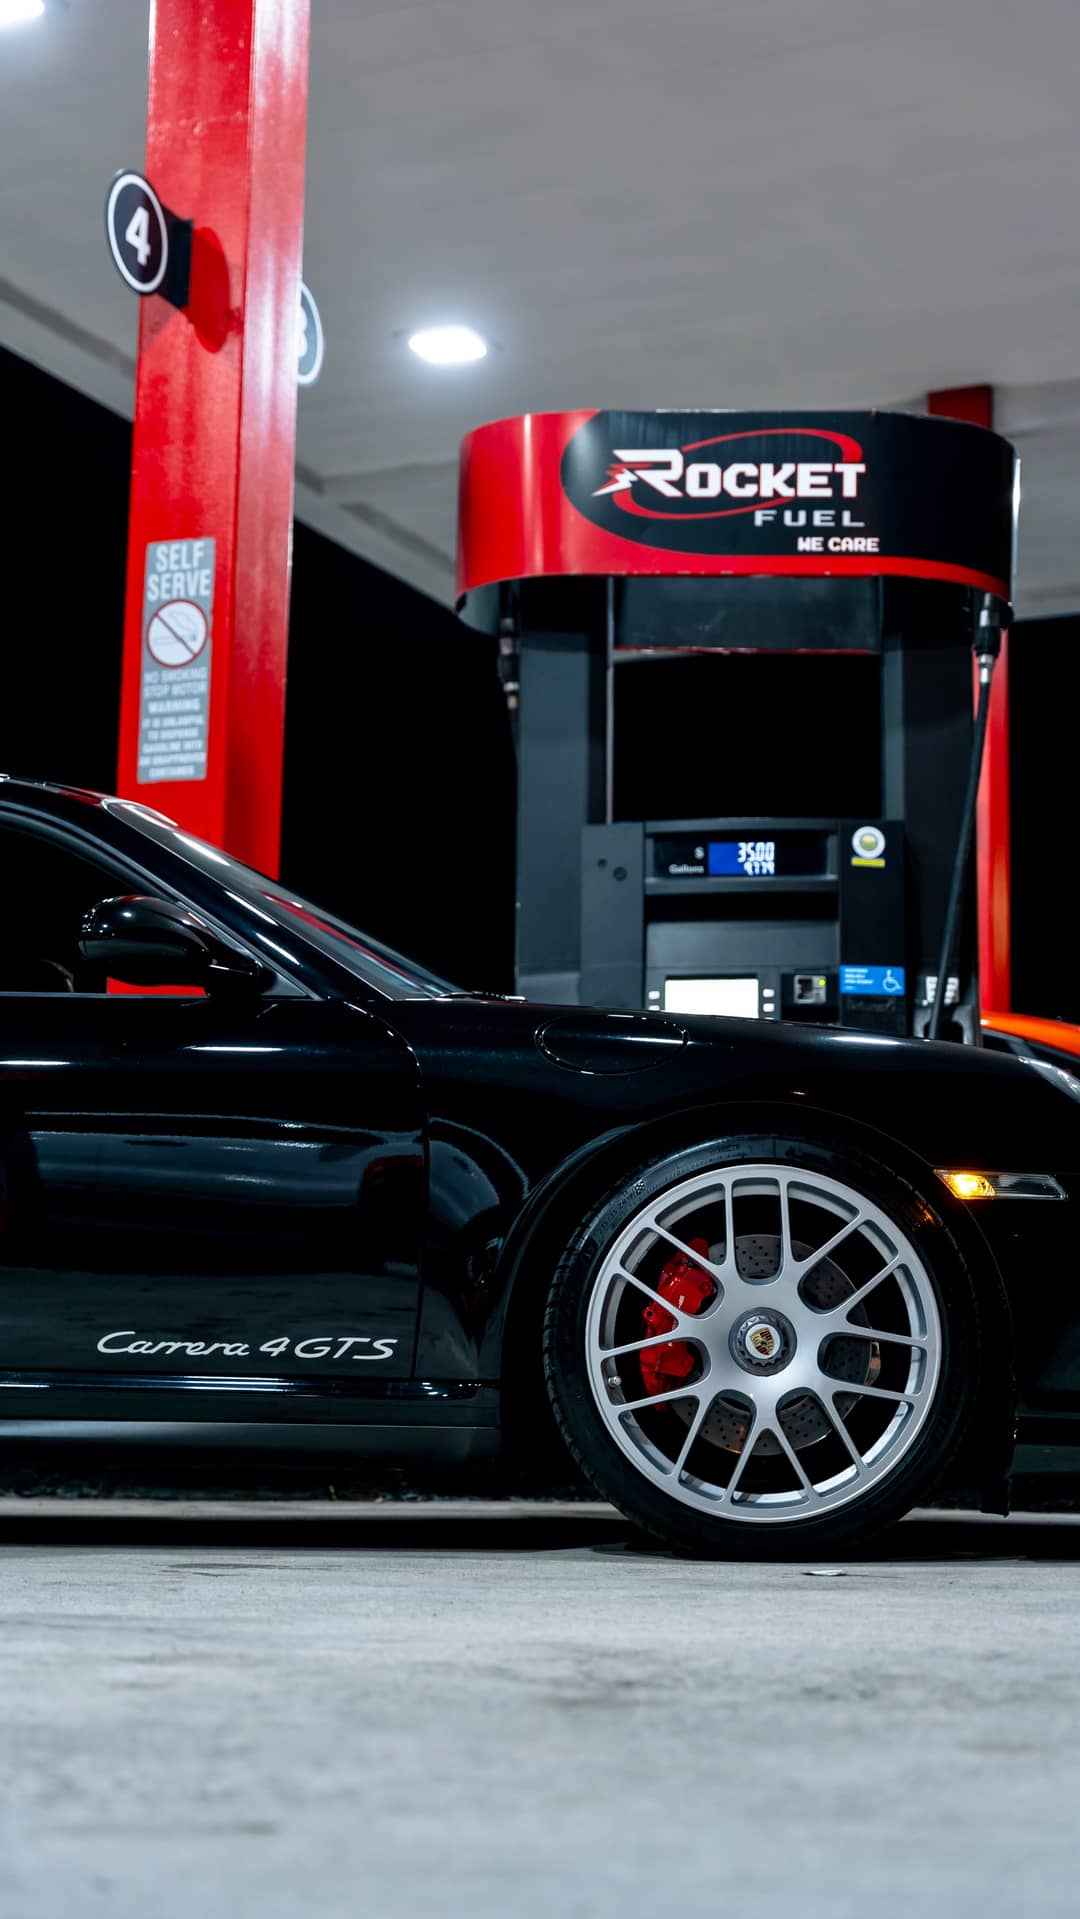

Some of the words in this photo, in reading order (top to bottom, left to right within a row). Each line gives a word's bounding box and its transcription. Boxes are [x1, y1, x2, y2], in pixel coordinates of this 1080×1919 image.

[125, 206, 151, 266] 4
[610, 449, 866, 497] ROCKET
[753, 510, 865, 527] FUEL
[155, 541, 205, 572] SELF
[797, 537, 824, 552] WE
[827, 537, 880, 552] CARE
[146, 568, 211, 602] SERVE
[669, 864, 704, 874] Gallons
[97, 1331, 250, 1356] Carrera
[259, 1336, 291, 1357] 4
[294, 1337, 398, 1360] GTS
